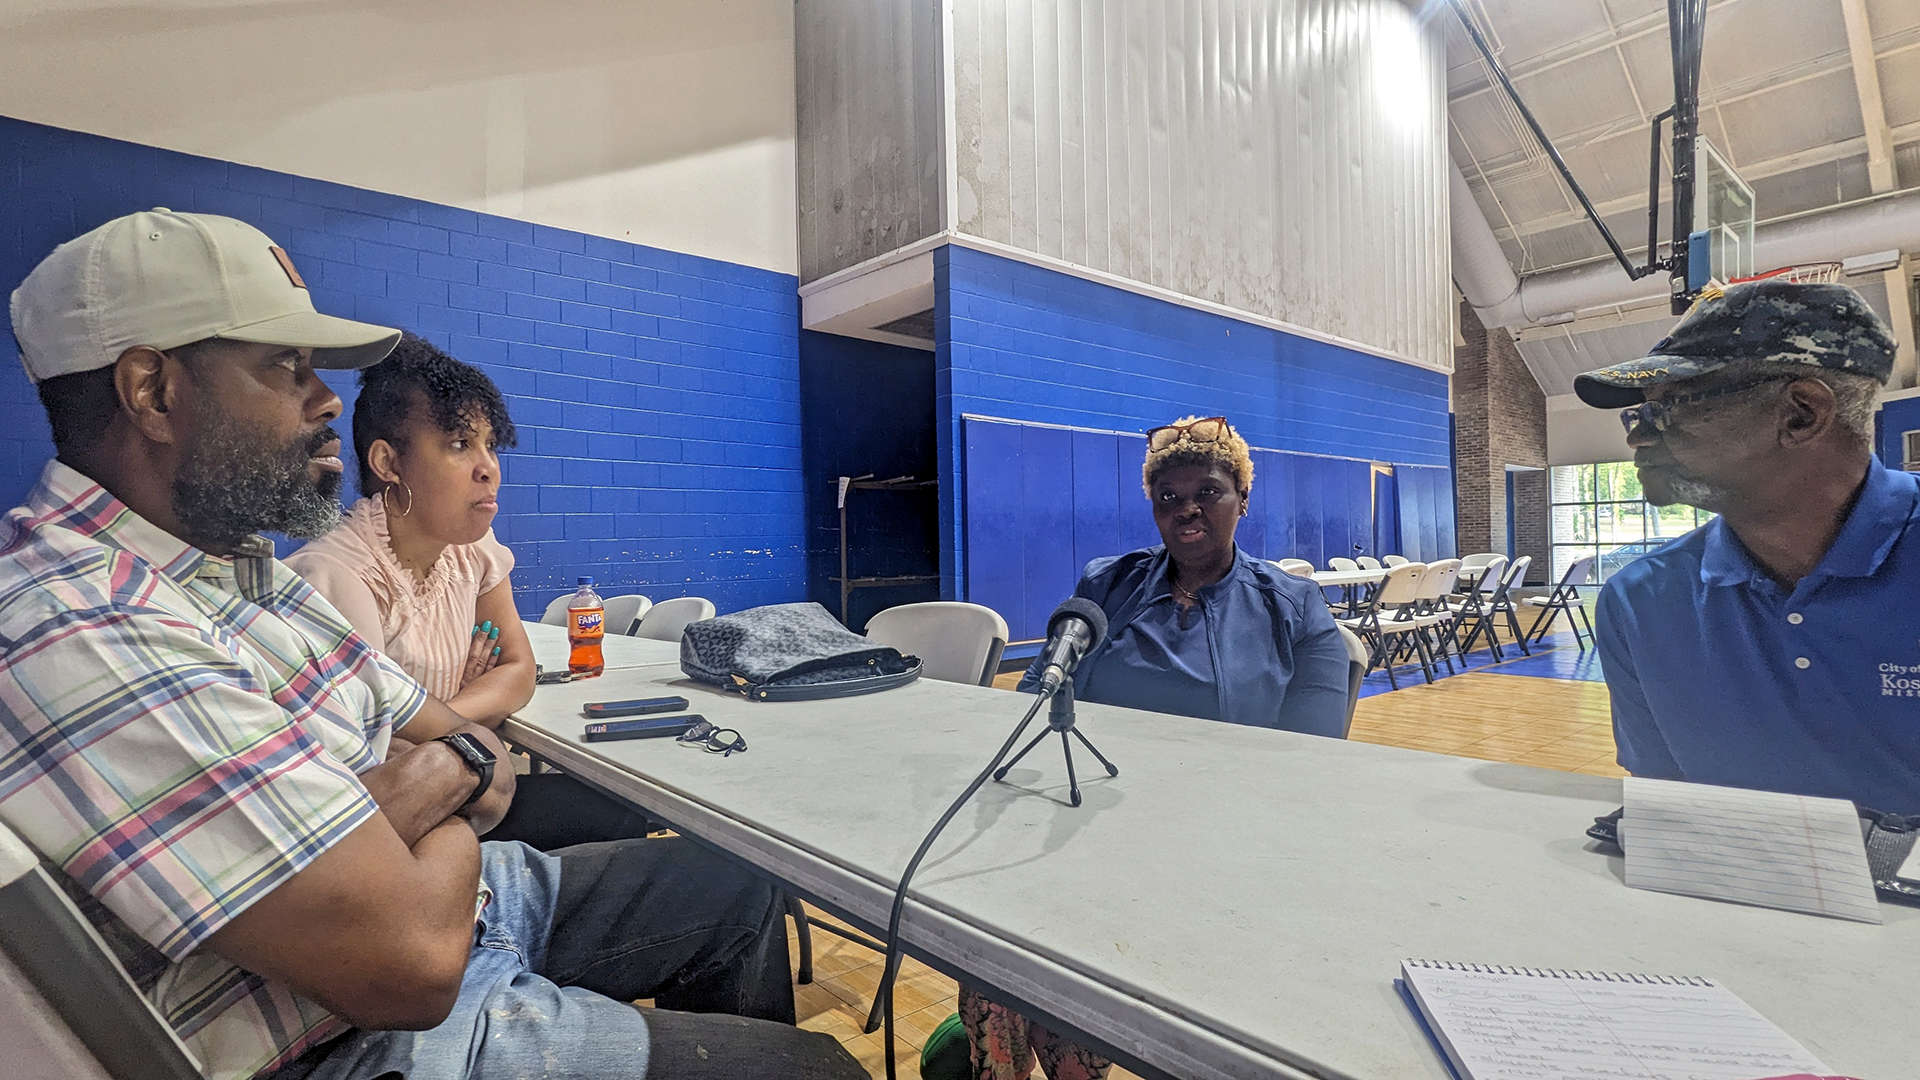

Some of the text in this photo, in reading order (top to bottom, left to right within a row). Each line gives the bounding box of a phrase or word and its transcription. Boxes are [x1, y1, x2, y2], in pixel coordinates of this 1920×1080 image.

[1627, 366, 1669, 379] NAVY
[1879, 663, 1907, 674] City
[1881, 673, 1920, 690] Kos
